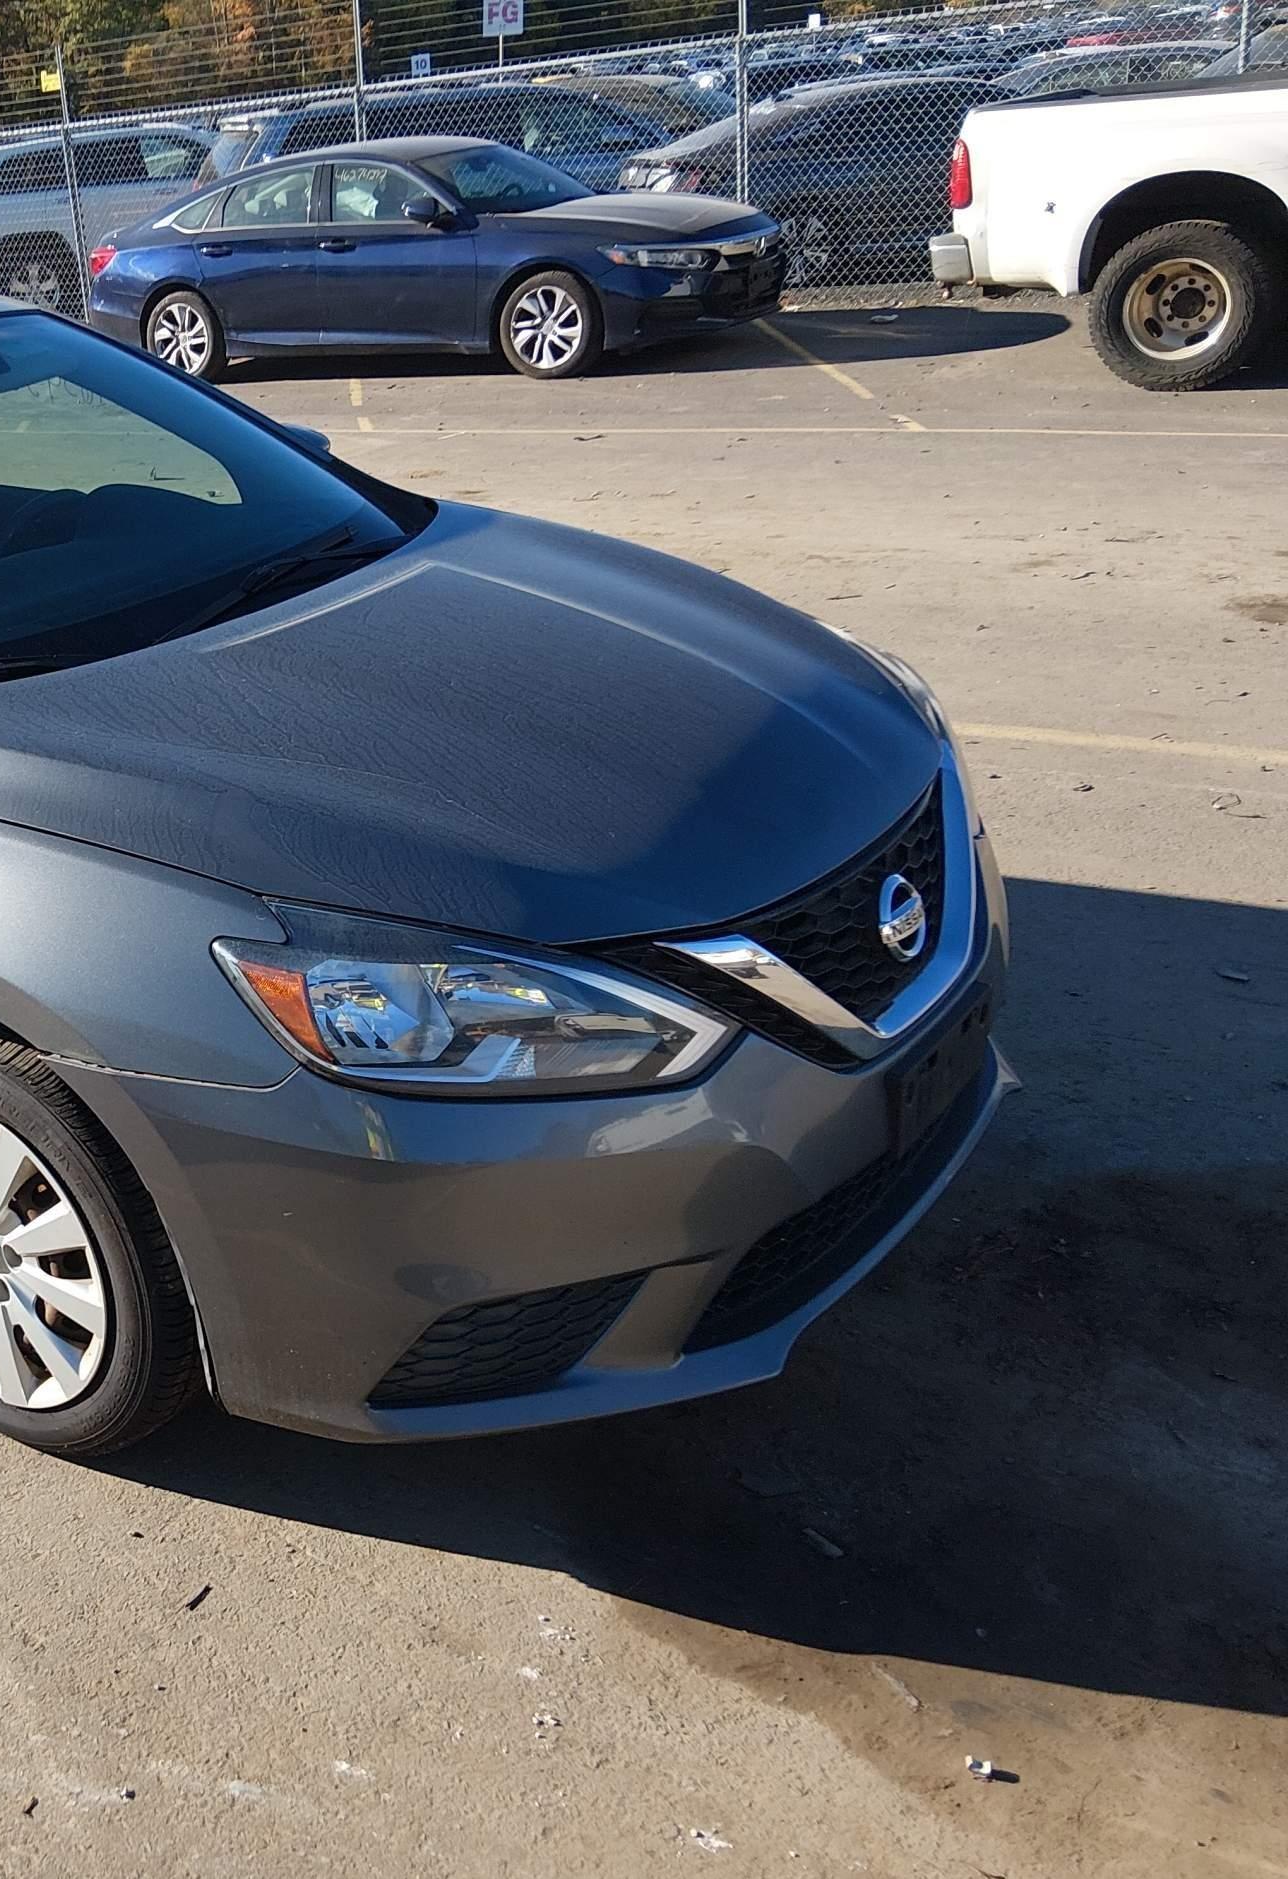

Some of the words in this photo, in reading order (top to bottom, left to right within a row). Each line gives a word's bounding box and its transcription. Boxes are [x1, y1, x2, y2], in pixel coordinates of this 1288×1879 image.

[487, 1, 519, 25] FG
[414, 59, 428, 71] 10
[890, 908, 924, 938] NISSA
